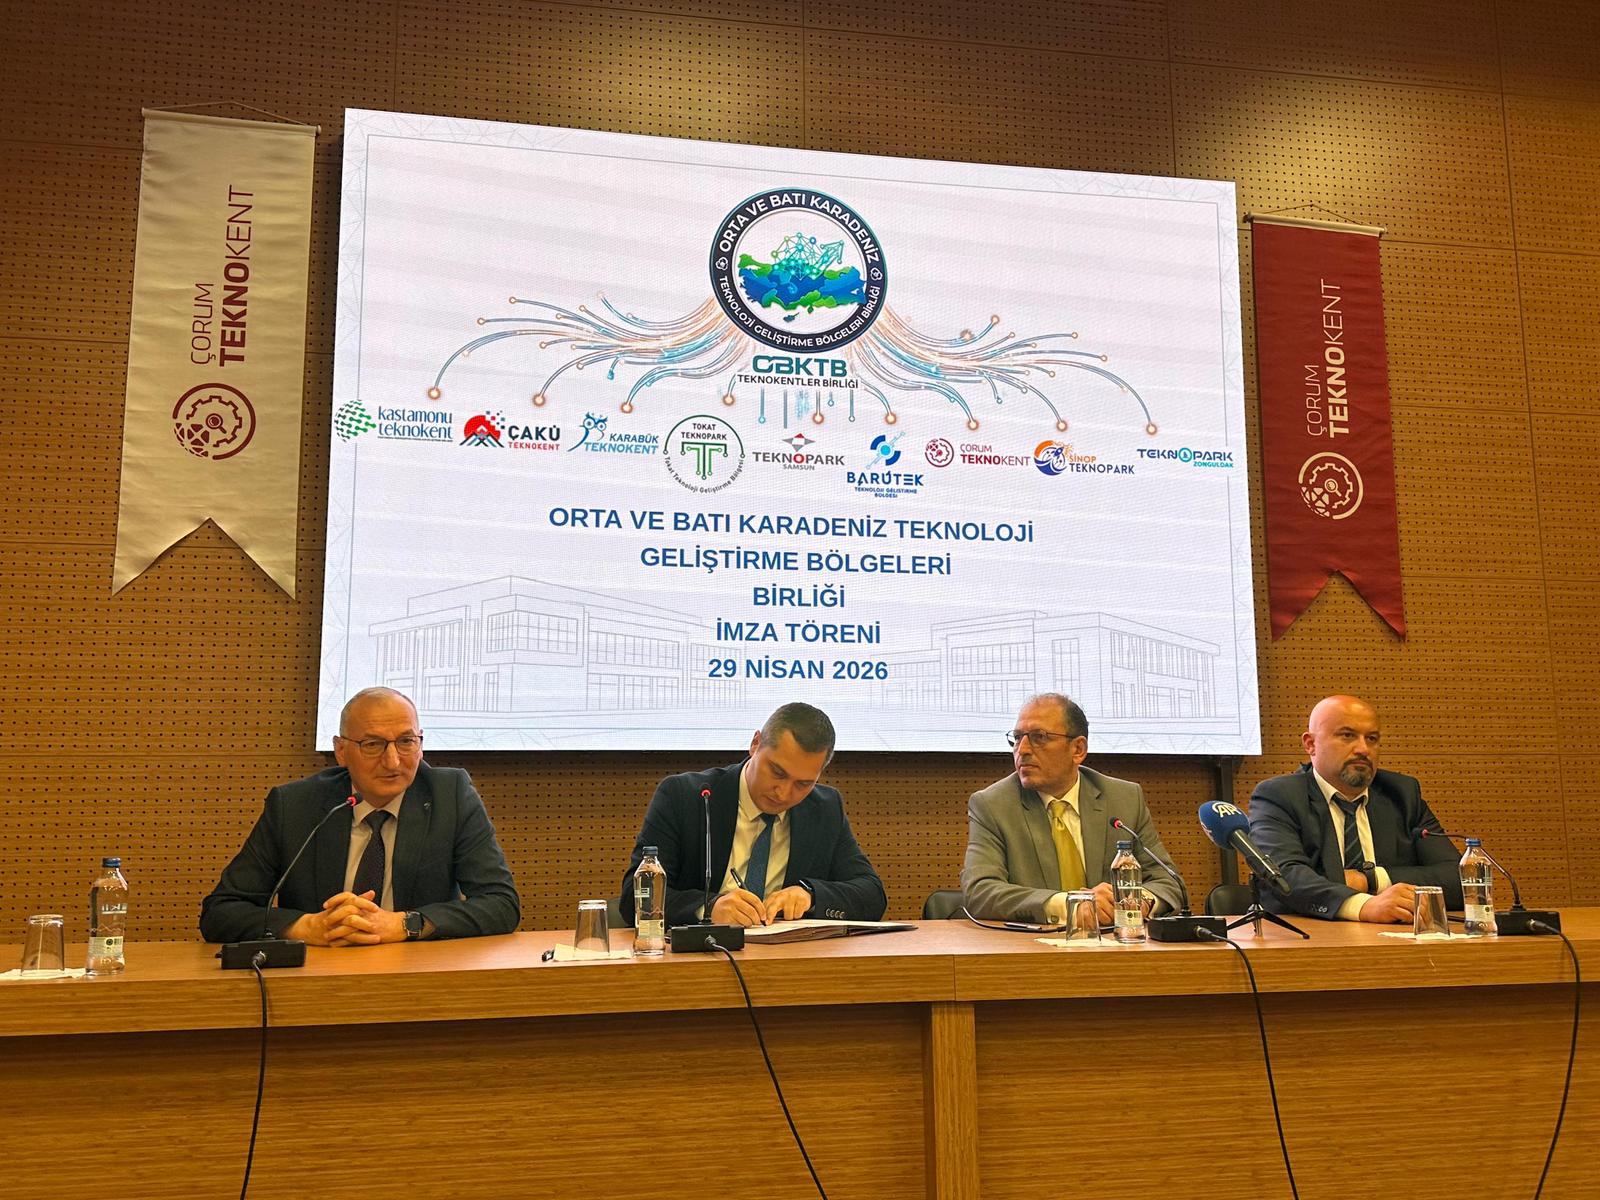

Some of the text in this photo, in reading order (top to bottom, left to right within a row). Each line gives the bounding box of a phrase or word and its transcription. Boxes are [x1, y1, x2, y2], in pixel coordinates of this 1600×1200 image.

[719, 193, 880, 264] ORTA VE BATI KARADENİZ
[219, 184, 254, 367] TEKNOKENT
[719, 275, 881, 347] TEKNOLOJİ GELİŞTİRME BÖLGELERİ BİRLİĞİ
[190, 283, 216, 365] ÇORUM
[1320, 278, 1349, 438] TEKNOKENT
[737, 374, 859, 389] TEKNOKENTLER BİRLİĞİ
[1305, 364, 1327, 436] ÇORUM
[378, 406, 453, 424] kastamonu
[378, 422, 453, 439] teknokent
[508, 425, 561, 441] ÇAKÜ
[692, 423, 716, 431] TOKAT
[609, 433, 659, 444] KARABÜK
[681, 431, 727, 440] TEKNOPARK
[508, 441, 560, 451] TEKNOKENT
[584, 441, 659, 454] TEKNOKENT
[960, 443, 992, 454] ÇORUM
[752, 451, 845, 466] TEKNOPARK
[960, 454, 1031, 467] TEKNOKENT
[1069, 453, 1097, 463] SİNOP
[1136, 447, 1233, 463] TEKNOPARK
[1069, 463, 1135, 475] TEKNOPARK
[549, 507, 1033, 542] ORTA VE BATI KARADENİZ TEKNOLOJİ
[640, 545, 951, 575] GELİŞTİRME BÖLGELERİ
[753, 583, 845, 608] BİRLİĞİ
[717, 617, 880, 643] İMZA TÖRENİ
[708, 655, 888, 680] 29 NİSAN 2026
